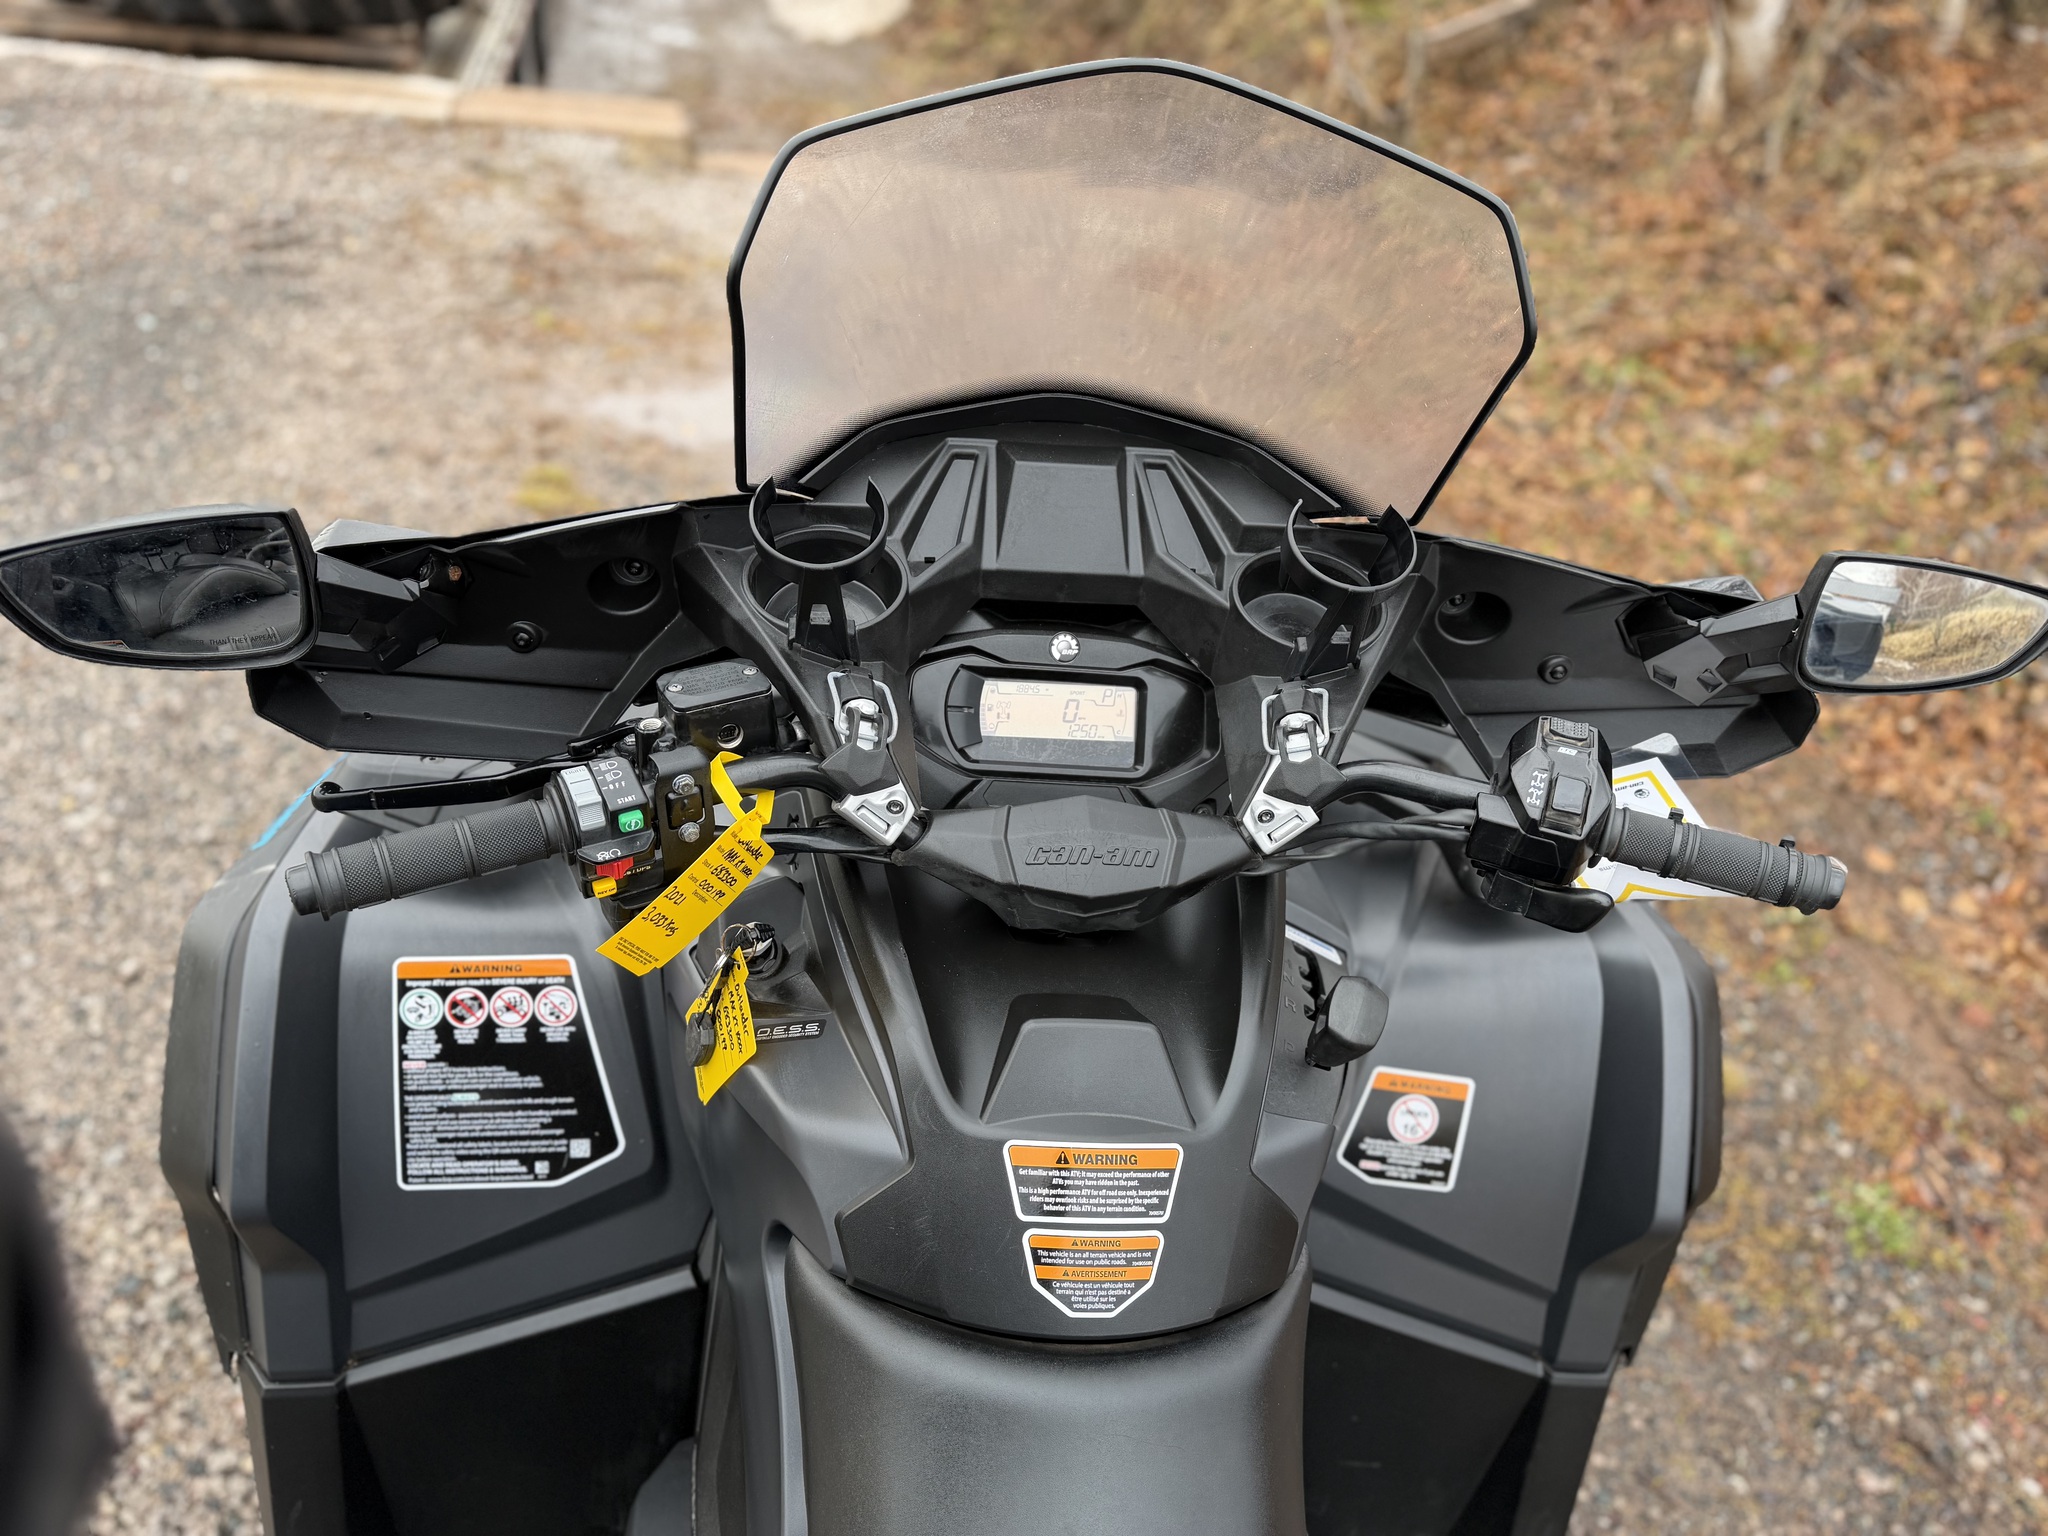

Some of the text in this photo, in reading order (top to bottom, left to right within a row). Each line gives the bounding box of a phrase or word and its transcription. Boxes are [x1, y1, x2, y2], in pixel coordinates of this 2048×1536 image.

[1101, 688, 1114, 703] P
[1062, 699, 1080, 723] 0
[1067, 723, 1098, 739] 1250
[617, 794, 636, 805] START
[1025, 844, 1160, 868] can-am
[664, 885, 687, 906] 2021
[463, 964, 523, 974] WARNING
[1403, 1123, 1419, 1136] 16
[1072, 1153, 1138, 1166] WARNING
[1019, 1168, 1028, 1176] Get
[1028, 1168, 1048, 1176] familiar
[1048, 1169, 1060, 1177] with
[1086, 1171, 1097, 1179] may
[1123, 1171, 1152, 1179] performance
[1074, 1179, 1084, 1187] may
[1128, 1179, 1140, 1187] past.
[1037, 1187, 1049, 1195] high
[1138, 1189, 1170, 1197] Inexperienced
[1106, 1197, 1127, 1205] surprised
[1128, 1197, 1134, 1205] by
[1143, 1197, 1159, 1205] specific
[1080, 1240, 1121, 1248] WARNING
[1049, 1250, 1068, 1258] vehicle
[1071, 1270, 1128, 1278] AVERTISSEMENT
